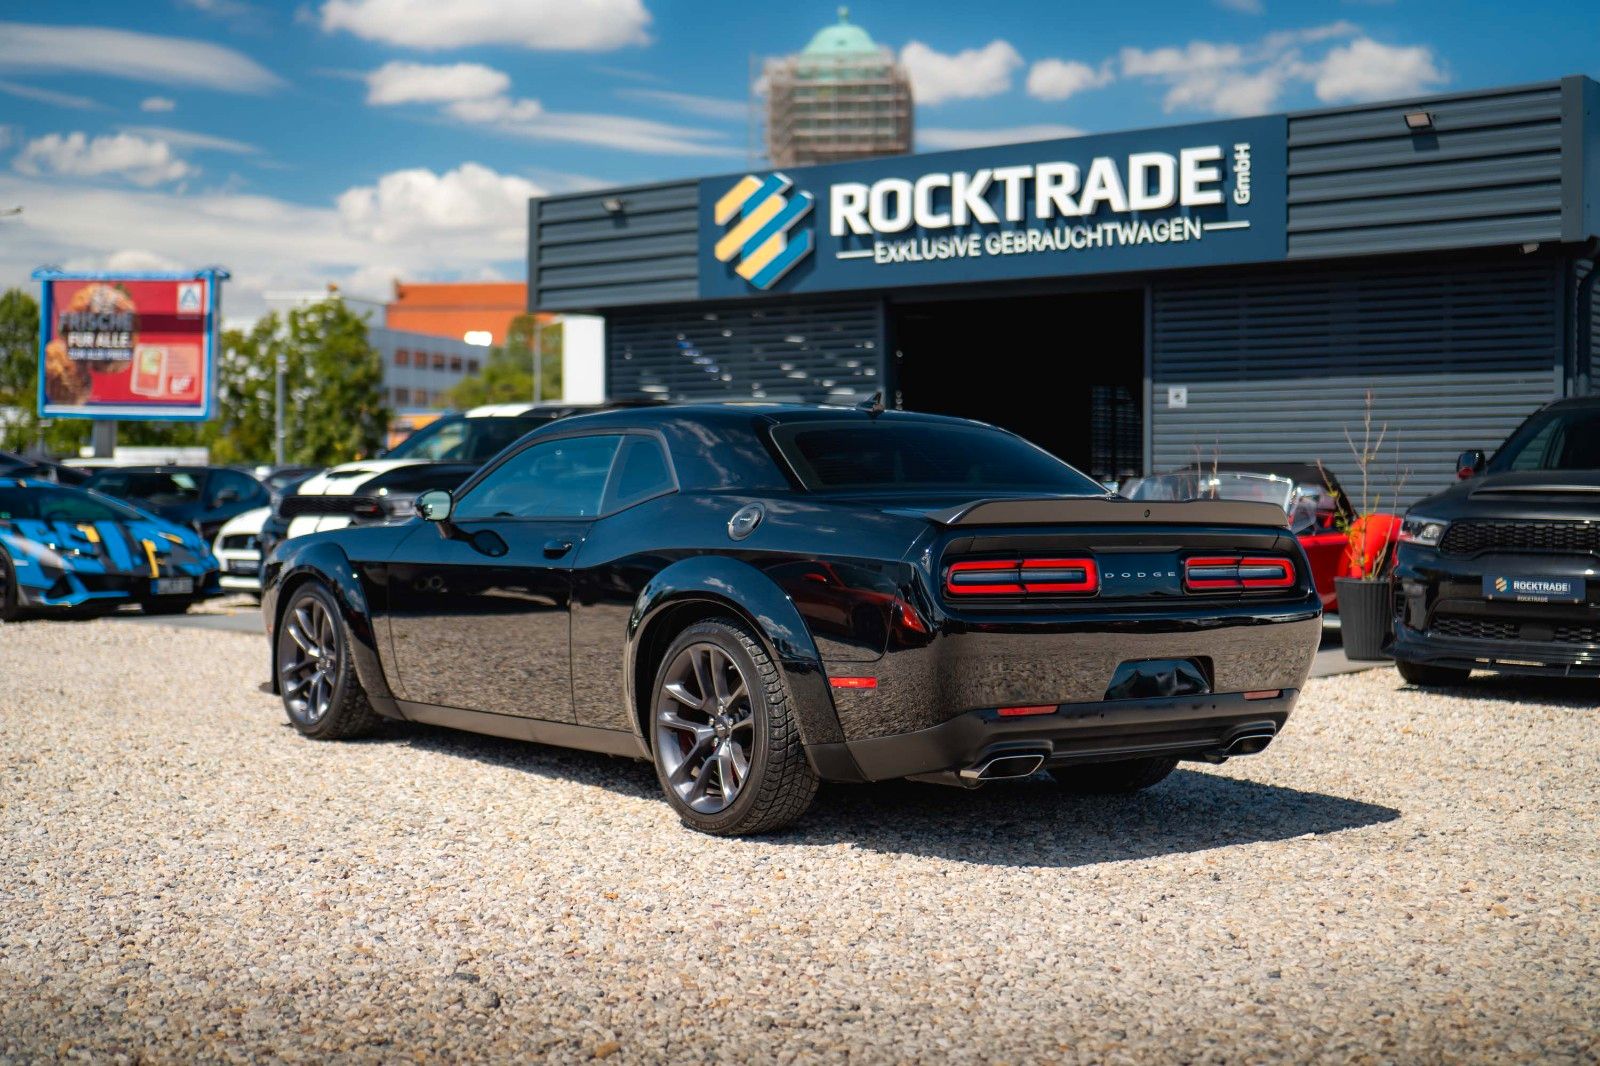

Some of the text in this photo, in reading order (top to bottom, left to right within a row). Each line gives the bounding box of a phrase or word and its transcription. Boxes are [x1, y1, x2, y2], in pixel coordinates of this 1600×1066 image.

[1233, 142, 1251, 205] GmbH
[830, 145, 1223, 236] ROCKTRADE
[874, 216, 1201, 264] EXKLUSIVE GEBRAUCHTWAGEN
[95, 331, 130, 348] ALLE
[1104, 571, 1176, 579] DODGE
[1513, 580, 1568, 592] ROCKTRADE
